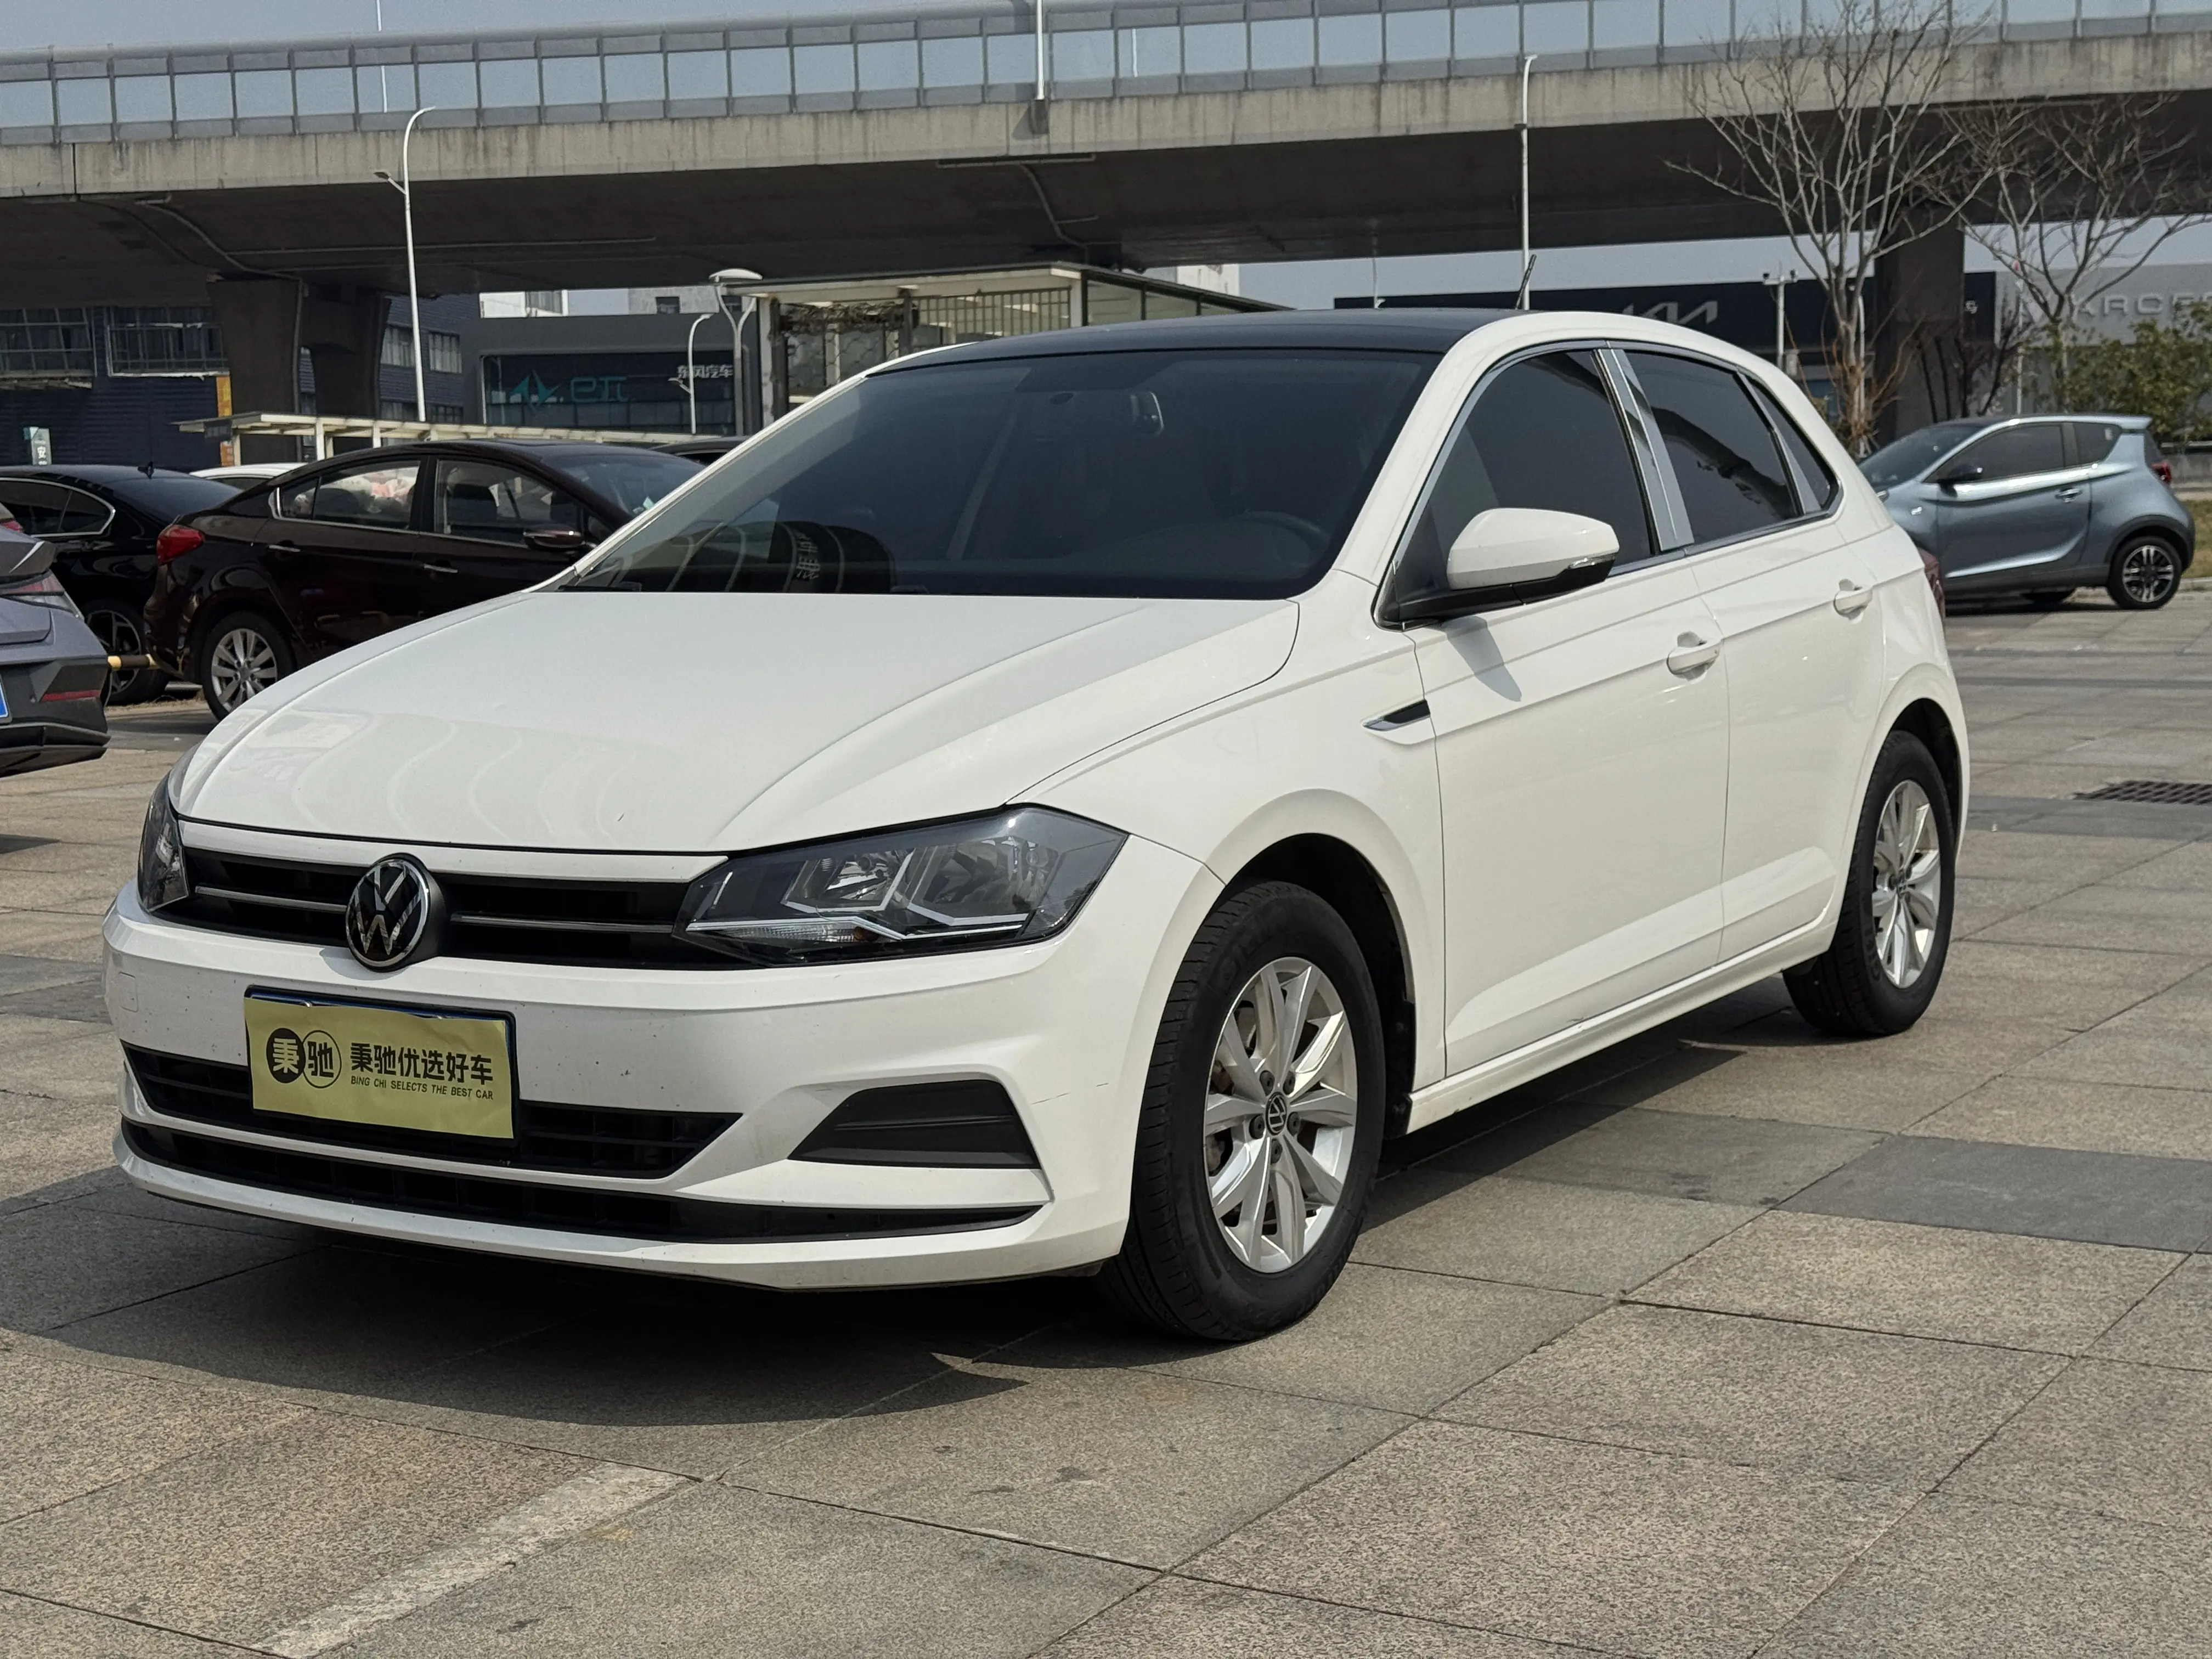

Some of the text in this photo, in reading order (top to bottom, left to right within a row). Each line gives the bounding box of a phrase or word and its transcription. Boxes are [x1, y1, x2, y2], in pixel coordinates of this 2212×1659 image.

[677, 364, 733, 378] 东风汽车
[273, 1037, 334, 1078] 秉驰
[350, 1042, 493, 1085] 秉驰优选好车
[351, 1075, 493, 1100] BING CHI SELECTS THE BEST CAR
